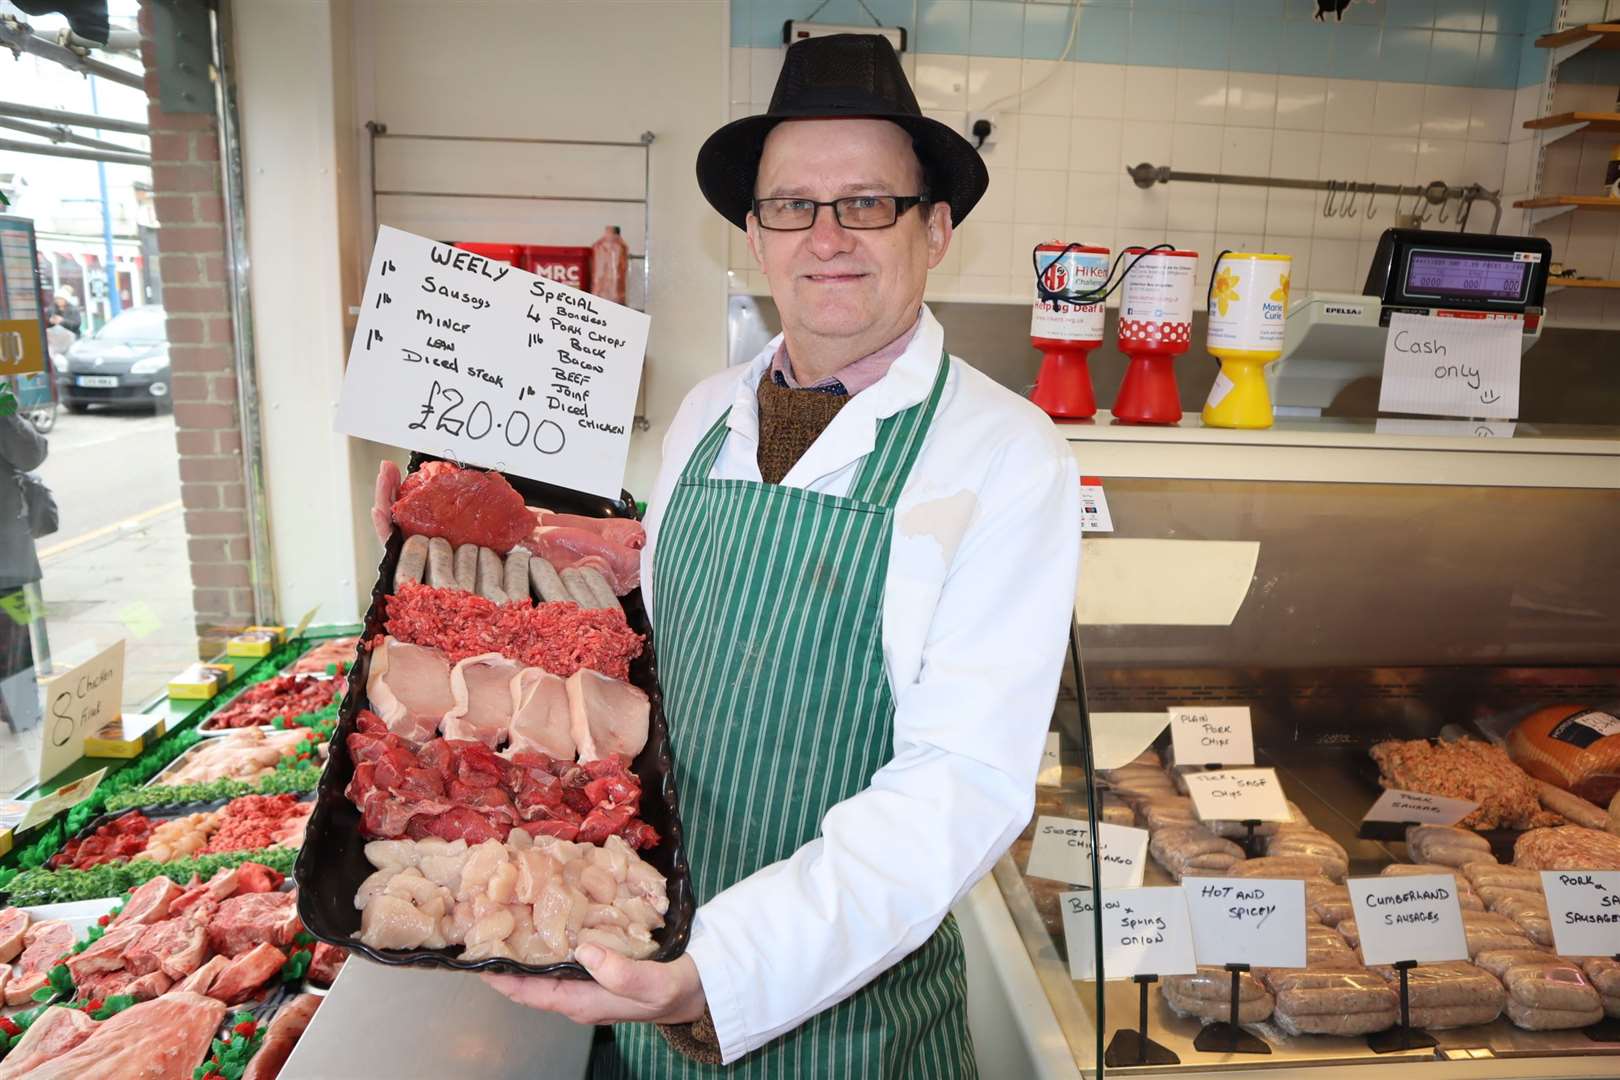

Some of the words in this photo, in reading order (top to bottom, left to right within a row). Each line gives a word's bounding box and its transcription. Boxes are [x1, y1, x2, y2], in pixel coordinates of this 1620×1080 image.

[430, 246, 509, 282] WEELY
[526, 304, 541, 323] 4
[1264, 311, 1283, 320] Curie
[1394, 330, 1446, 355] Cash
[551, 367, 591, 386] BEEF
[1434, 364, 1480, 389] only
[408, 380, 566, 454] £20.00
[52, 691, 74, 747] 8
[1180, 714, 1208, 723] PLAIN
[1559, 874, 1594, 886] PORK
[1202, 886, 1234, 898] HOT
[1236, 889, 1265, 900] AND
[1365, 888, 1450, 907] CUMBERLAND
